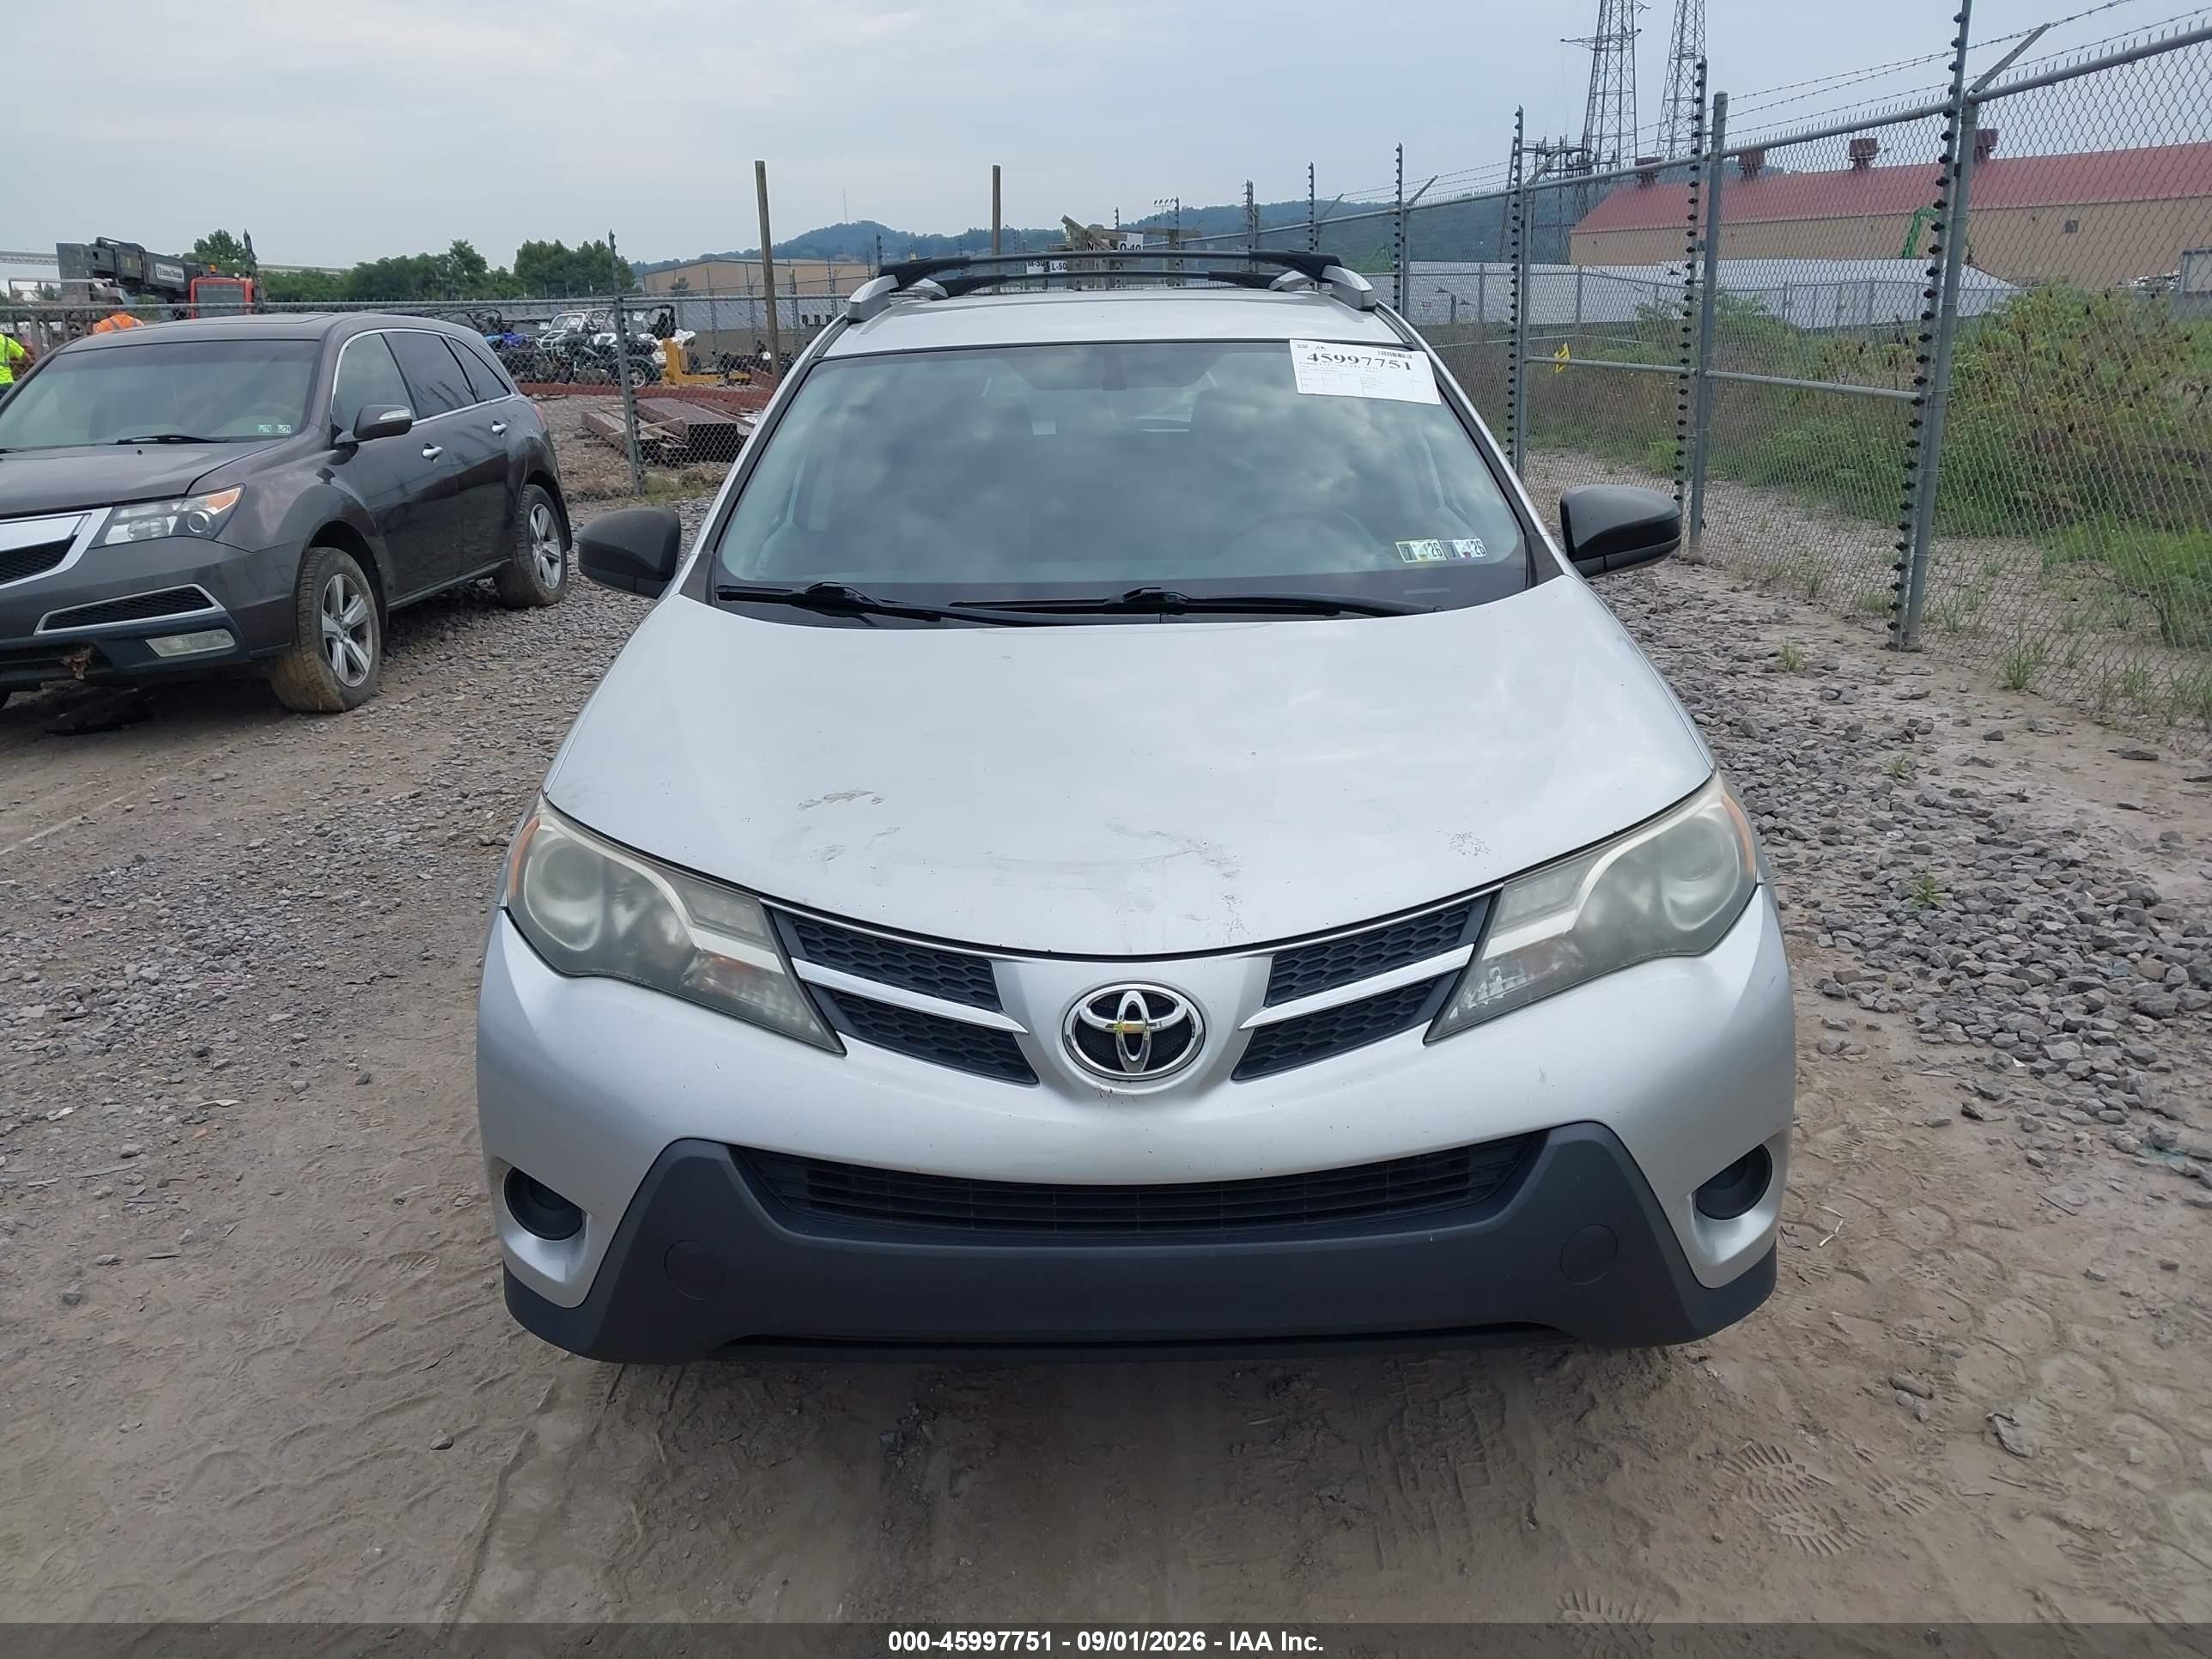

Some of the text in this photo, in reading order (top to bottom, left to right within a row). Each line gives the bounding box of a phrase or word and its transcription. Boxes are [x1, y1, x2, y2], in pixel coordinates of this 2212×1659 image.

[1052, 262, 1067, 270] L-50
[1307, 352, 1413, 370] 45997751
[1428, 542, 1443, 557] 26
[1471, 540, 1486, 555] 26
